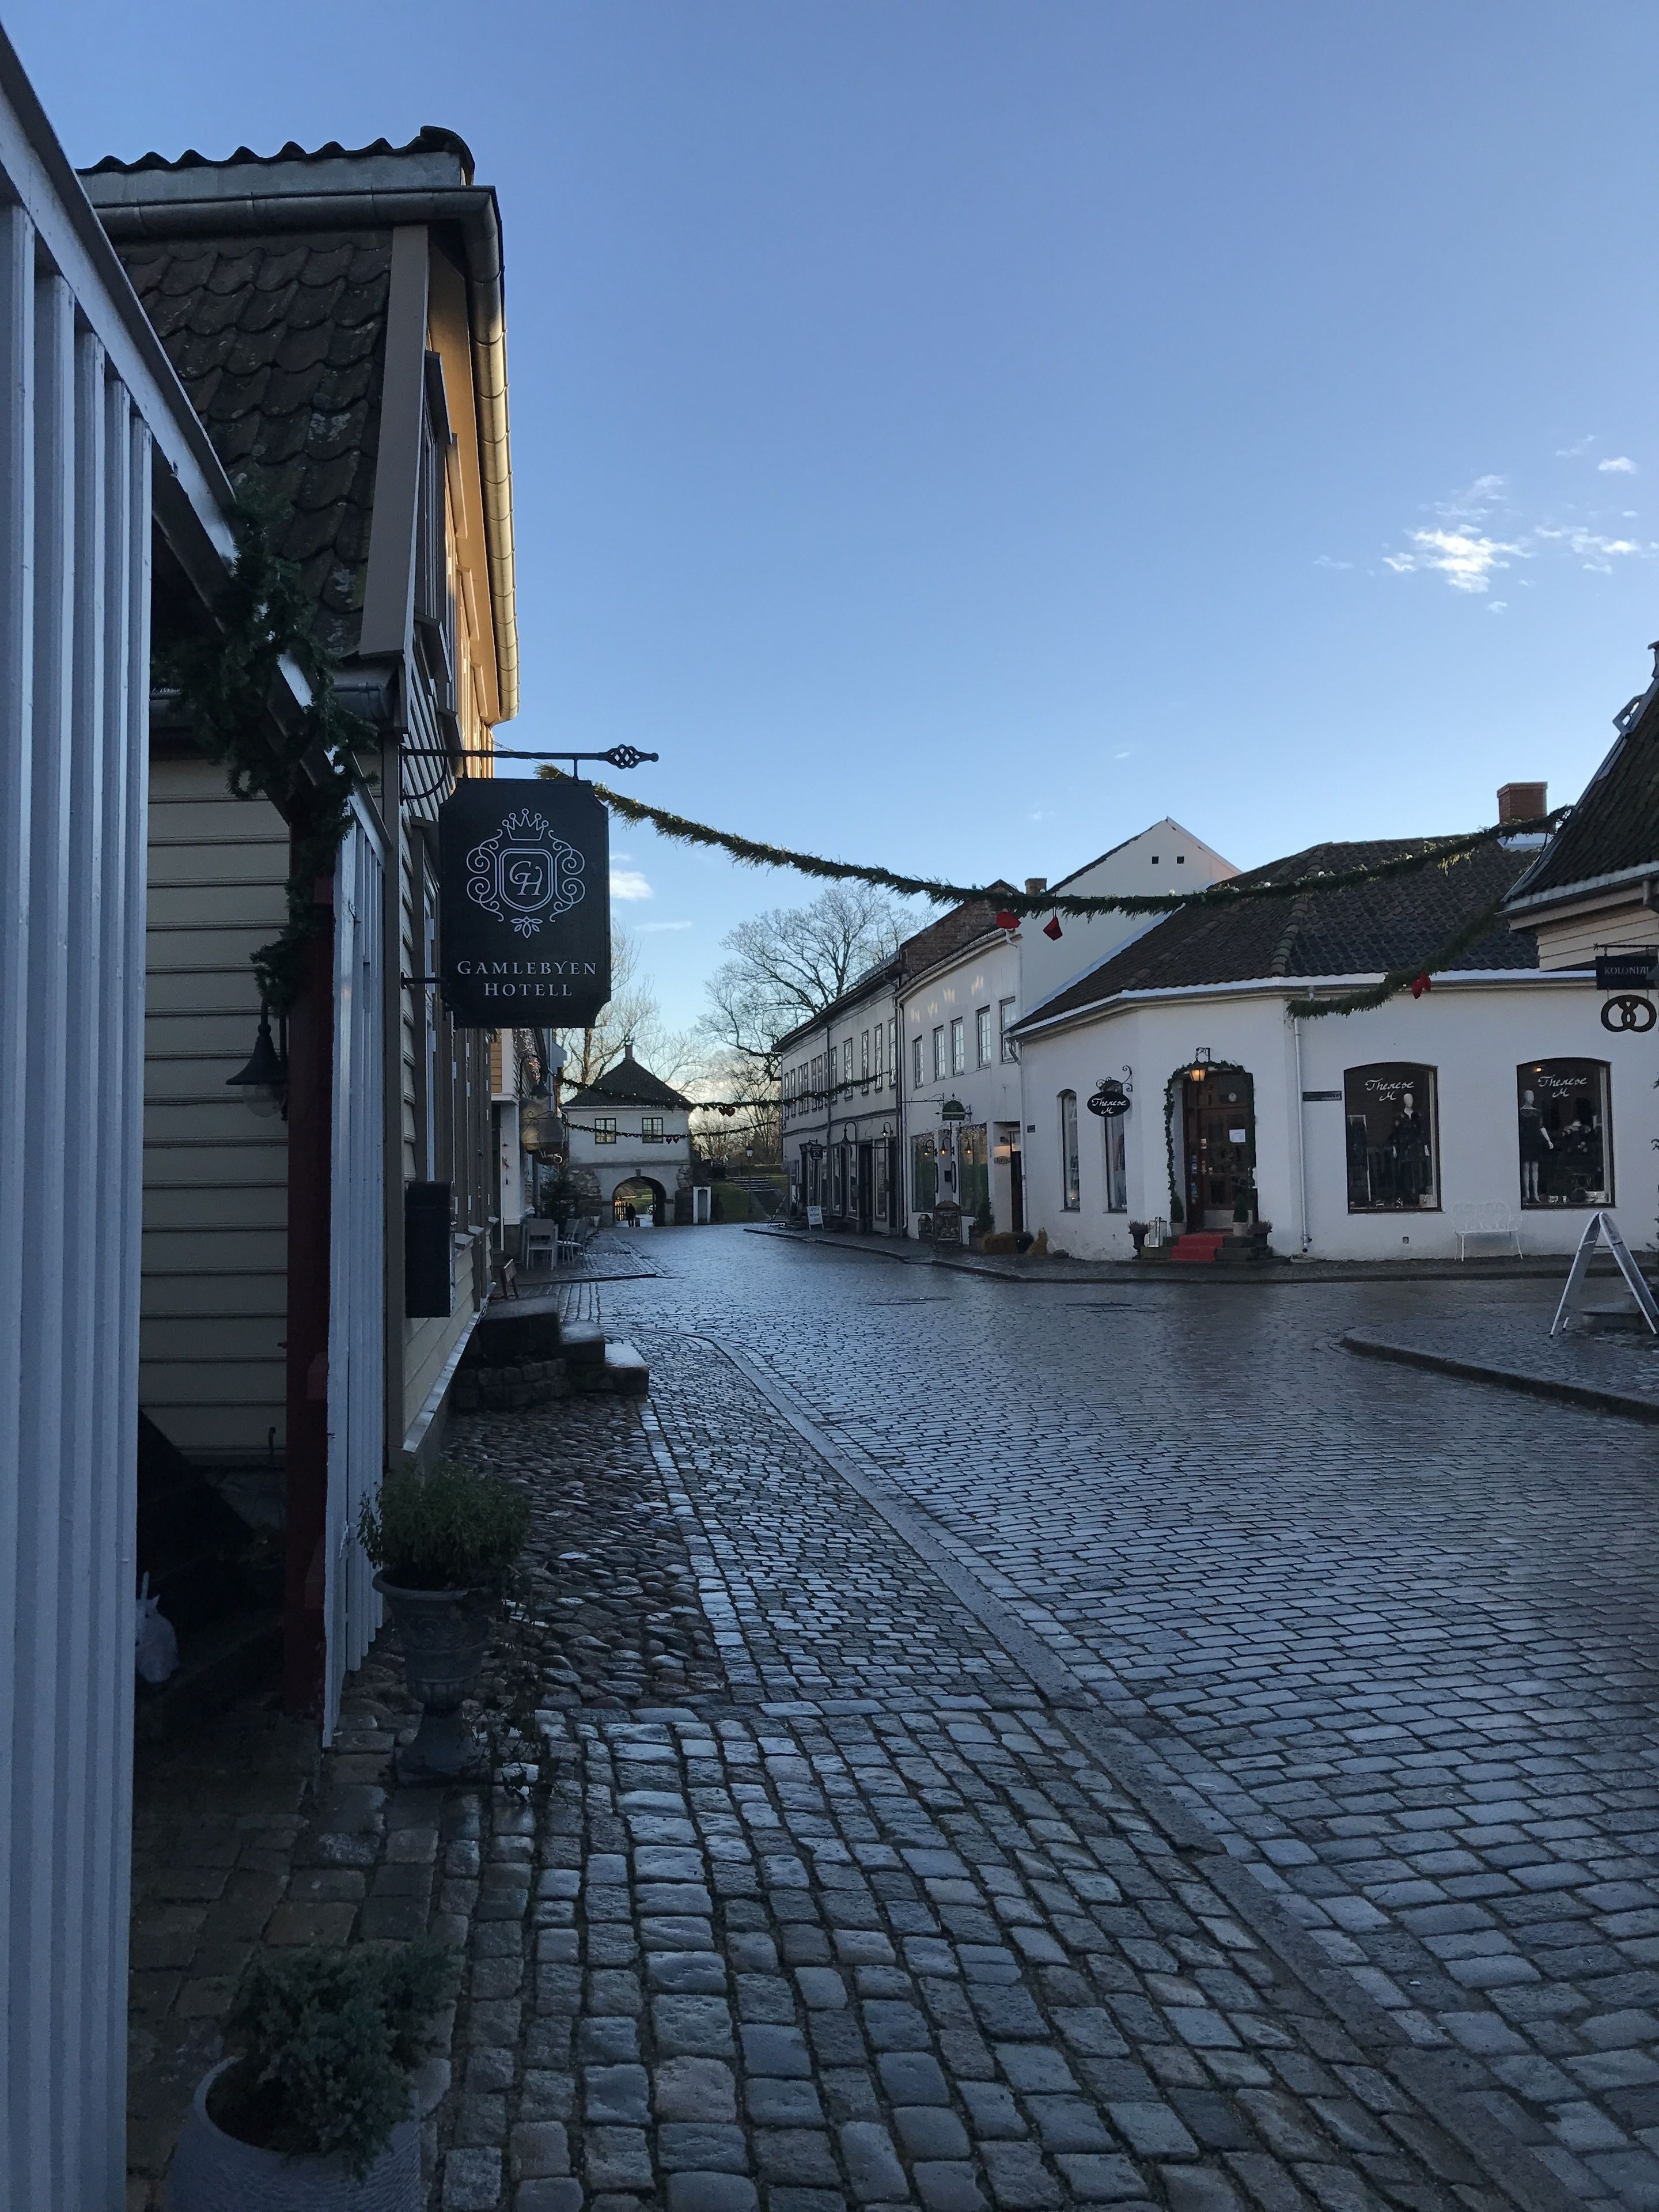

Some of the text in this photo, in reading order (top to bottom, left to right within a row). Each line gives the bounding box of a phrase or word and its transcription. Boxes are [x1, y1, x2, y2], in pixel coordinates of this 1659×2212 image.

[457, 961, 596, 975] GAMLEBYEN
[484, 983, 572, 996] HOTELL
[1365, 1078, 1414, 1090] Therese
[1537, 1074, 1587, 1087] Therese
[1379, 1092, 1396, 1101] M
[1552, 1088, 1569, 1098] M
[1091, 1097, 1126, 1106] Therese
